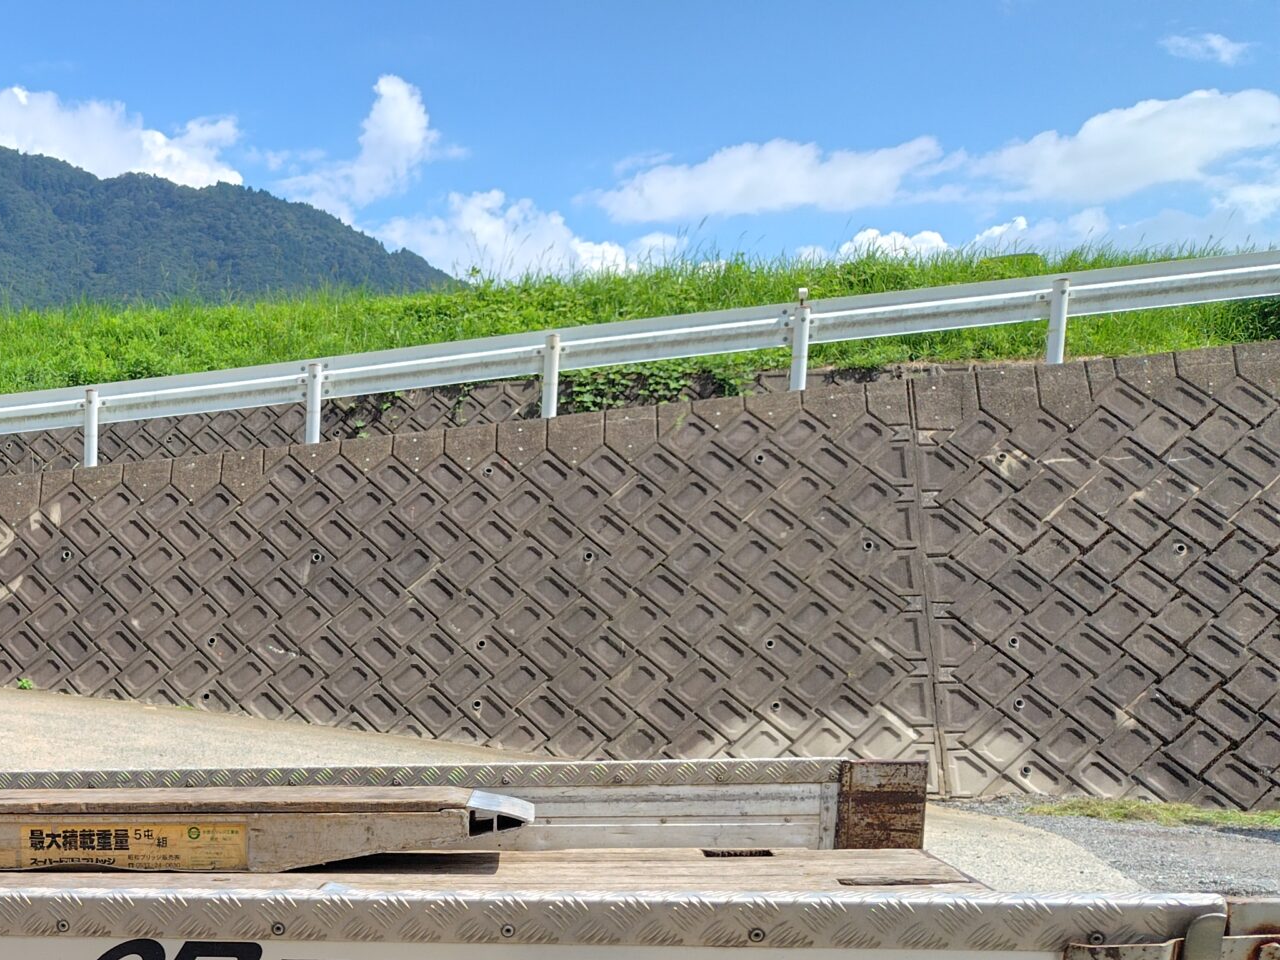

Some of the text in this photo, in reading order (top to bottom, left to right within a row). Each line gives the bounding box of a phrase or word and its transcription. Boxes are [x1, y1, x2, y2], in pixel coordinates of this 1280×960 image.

[29, 828, 130, 851] 最大積載重量
